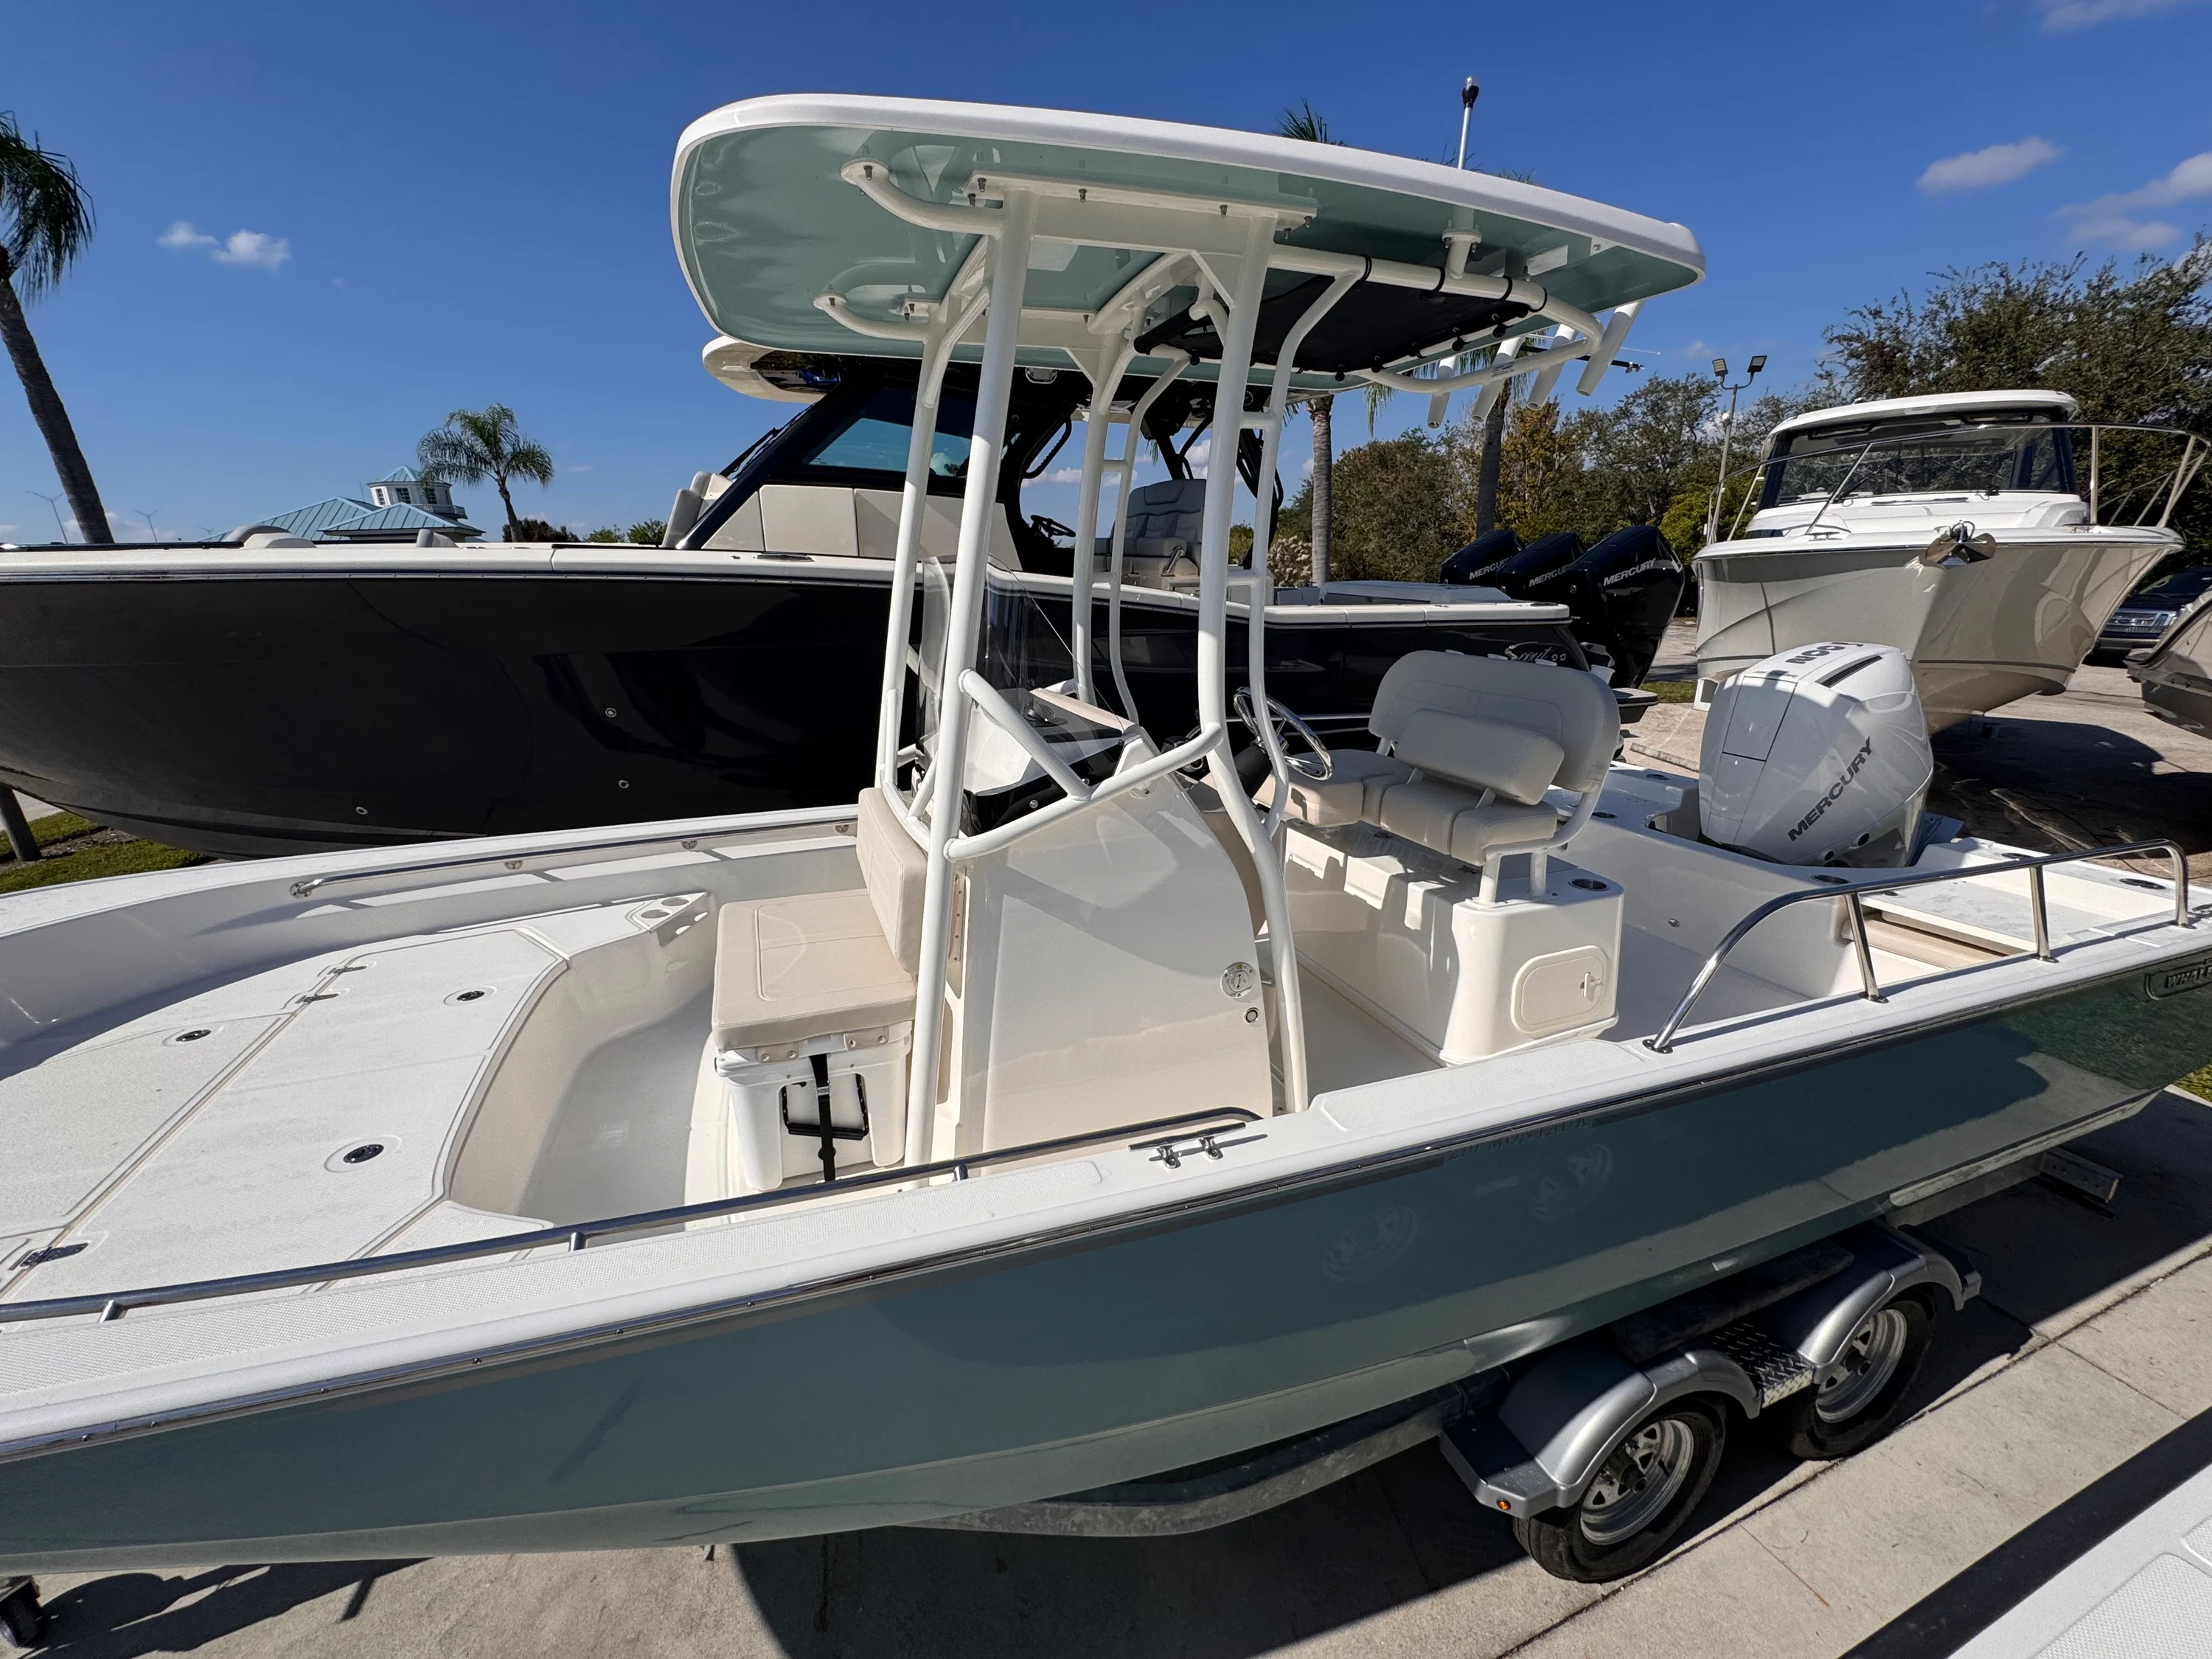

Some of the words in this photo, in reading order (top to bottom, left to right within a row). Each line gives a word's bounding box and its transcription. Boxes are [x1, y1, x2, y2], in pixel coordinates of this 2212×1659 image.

[1469, 556, 1512, 580] MERCU
[1528, 565, 1568, 587] MERCU
[1603, 557, 1656, 587] MERCURY
[1787, 736, 1871, 841] MERCURY
